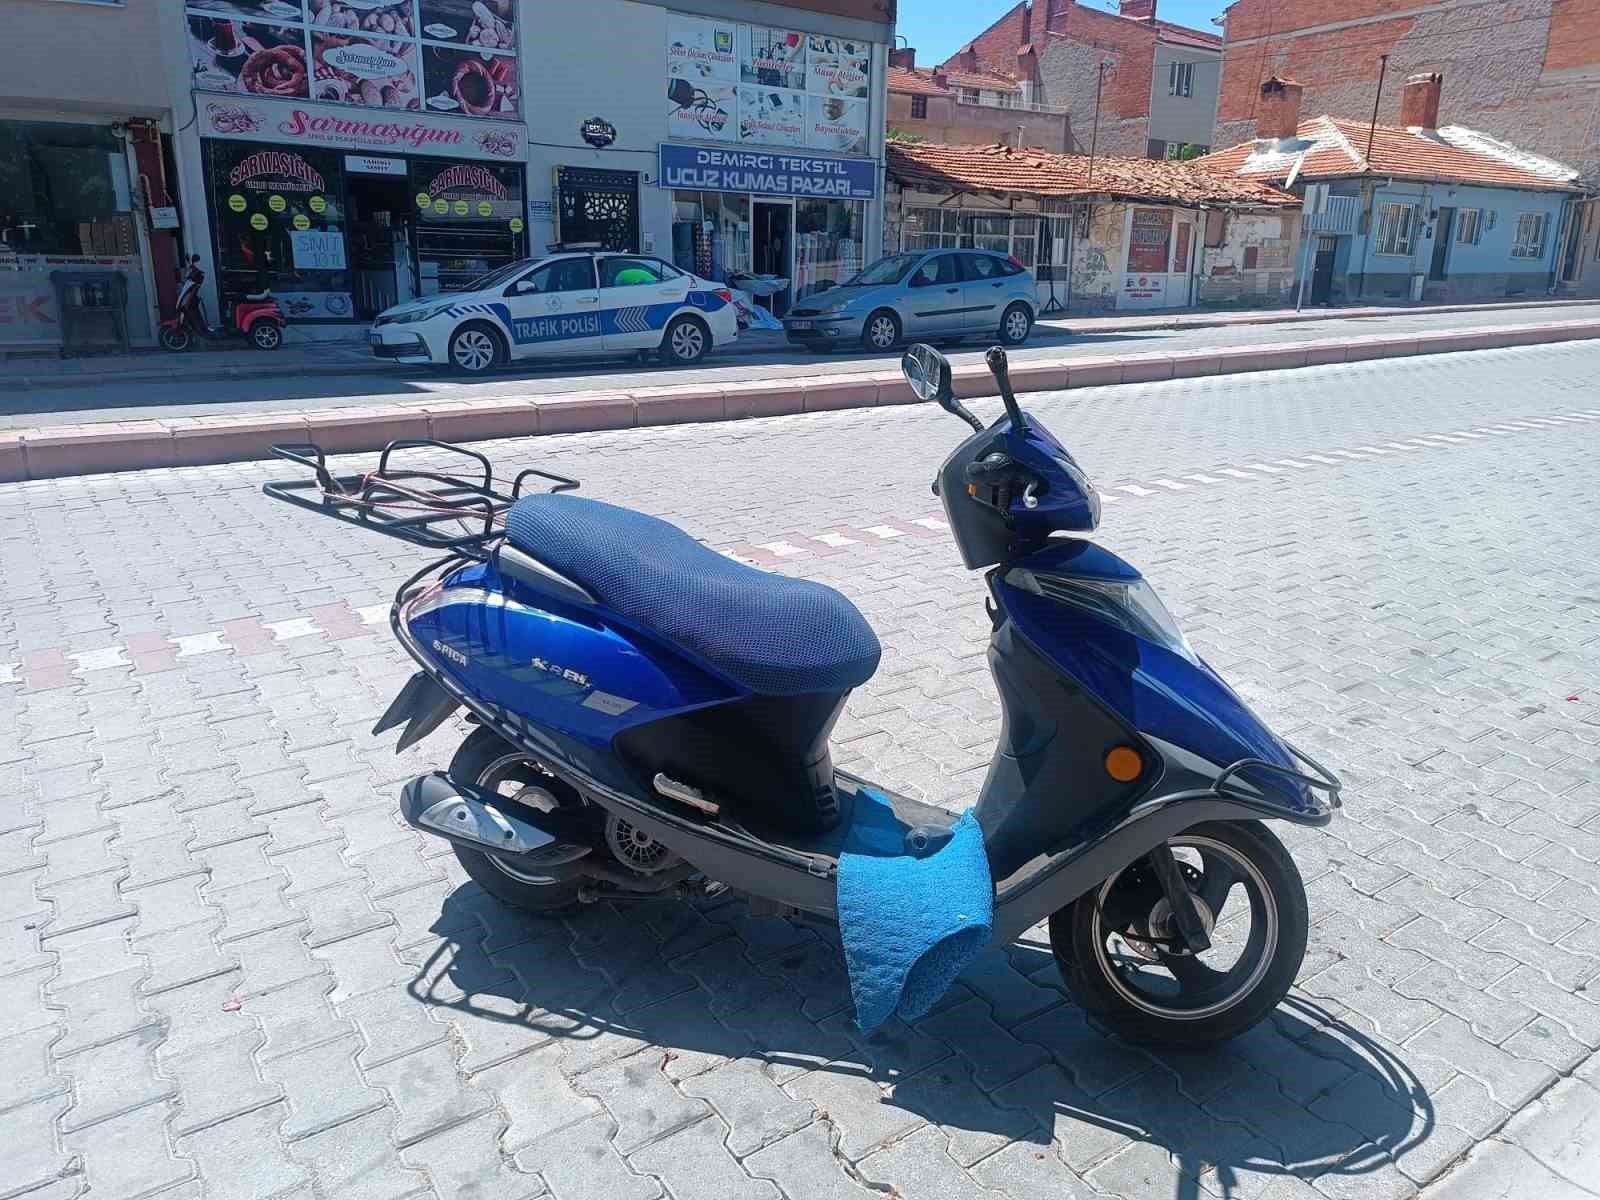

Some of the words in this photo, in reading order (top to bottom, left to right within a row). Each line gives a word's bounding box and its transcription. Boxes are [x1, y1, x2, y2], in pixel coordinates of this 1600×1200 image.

[667, 167, 718, 187] UCUZ
[791, 178, 850, 196] PAZARI
[433, 640, 467, 667] SPICA
